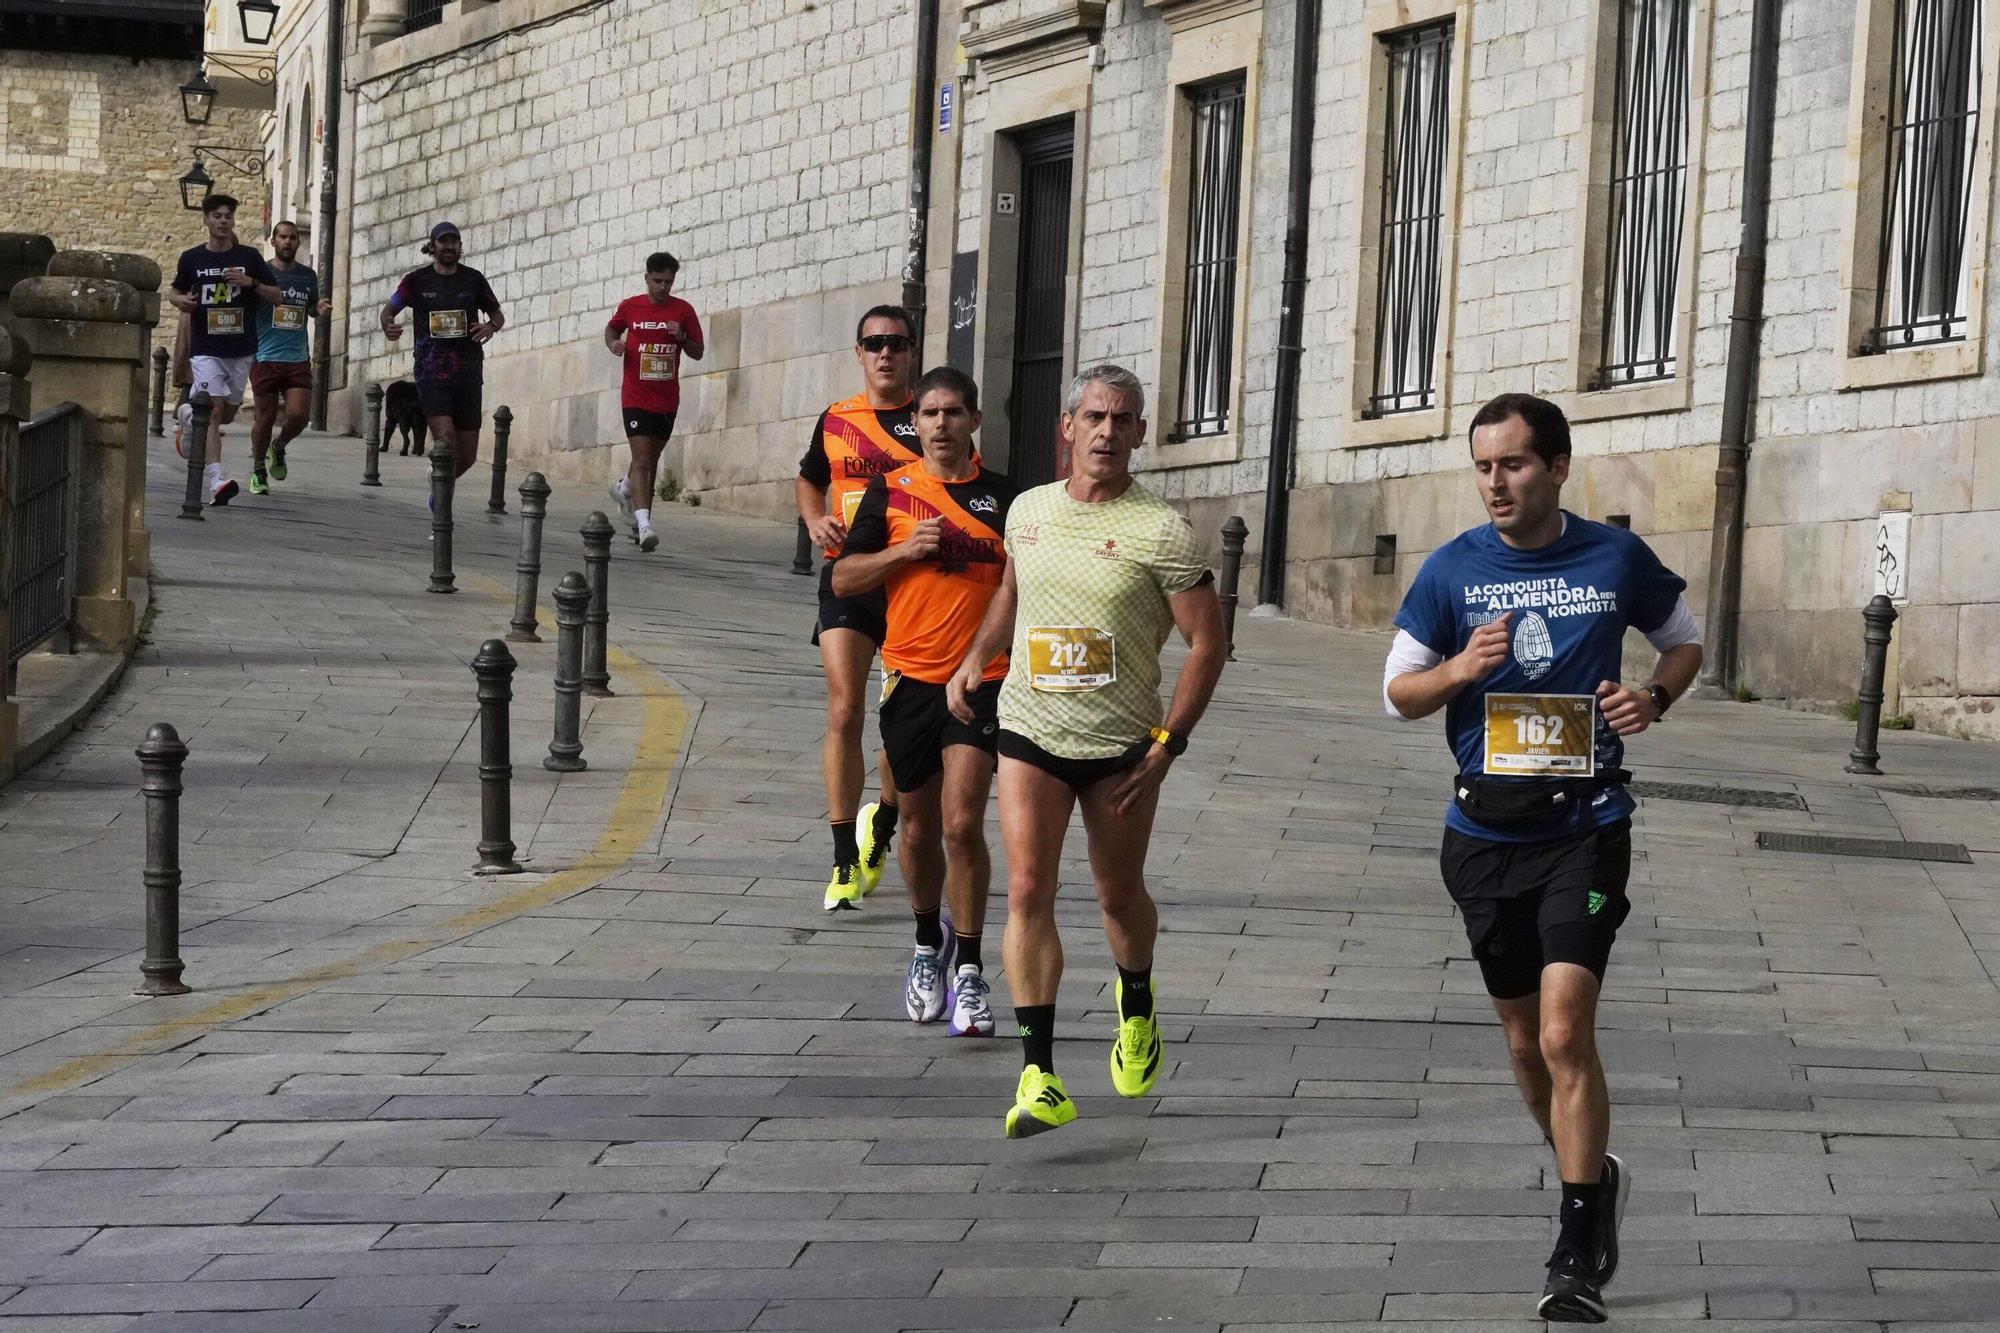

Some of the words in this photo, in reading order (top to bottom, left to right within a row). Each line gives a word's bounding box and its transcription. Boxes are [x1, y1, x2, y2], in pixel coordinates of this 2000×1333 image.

[1000, 195, 1011, 211] 3
[201, 281, 242, 304] CAP
[281, 287, 308, 300] TORIA
[283, 311, 297, 321] 247
[633, 321, 668, 330] HEA
[651, 361, 668, 371] 561
[844, 456, 908, 474] FOROND
[1465, 584, 1482, 597] LA
[1482, 577, 1567, 596] CONQUISTA
[1465, 597, 1476, 605] DE
[1487, 586, 1599, 611] ALMENDRA
[1600, 592, 1616, 600] REN
[1548, 600, 1617, 618] KONKISTA
[1049, 642, 1088, 667] 212
[1524, 661, 1551, 669] VITORIA
[1513, 714, 1564, 745] 162
[1526, 747, 1550, 755] JAVIER
